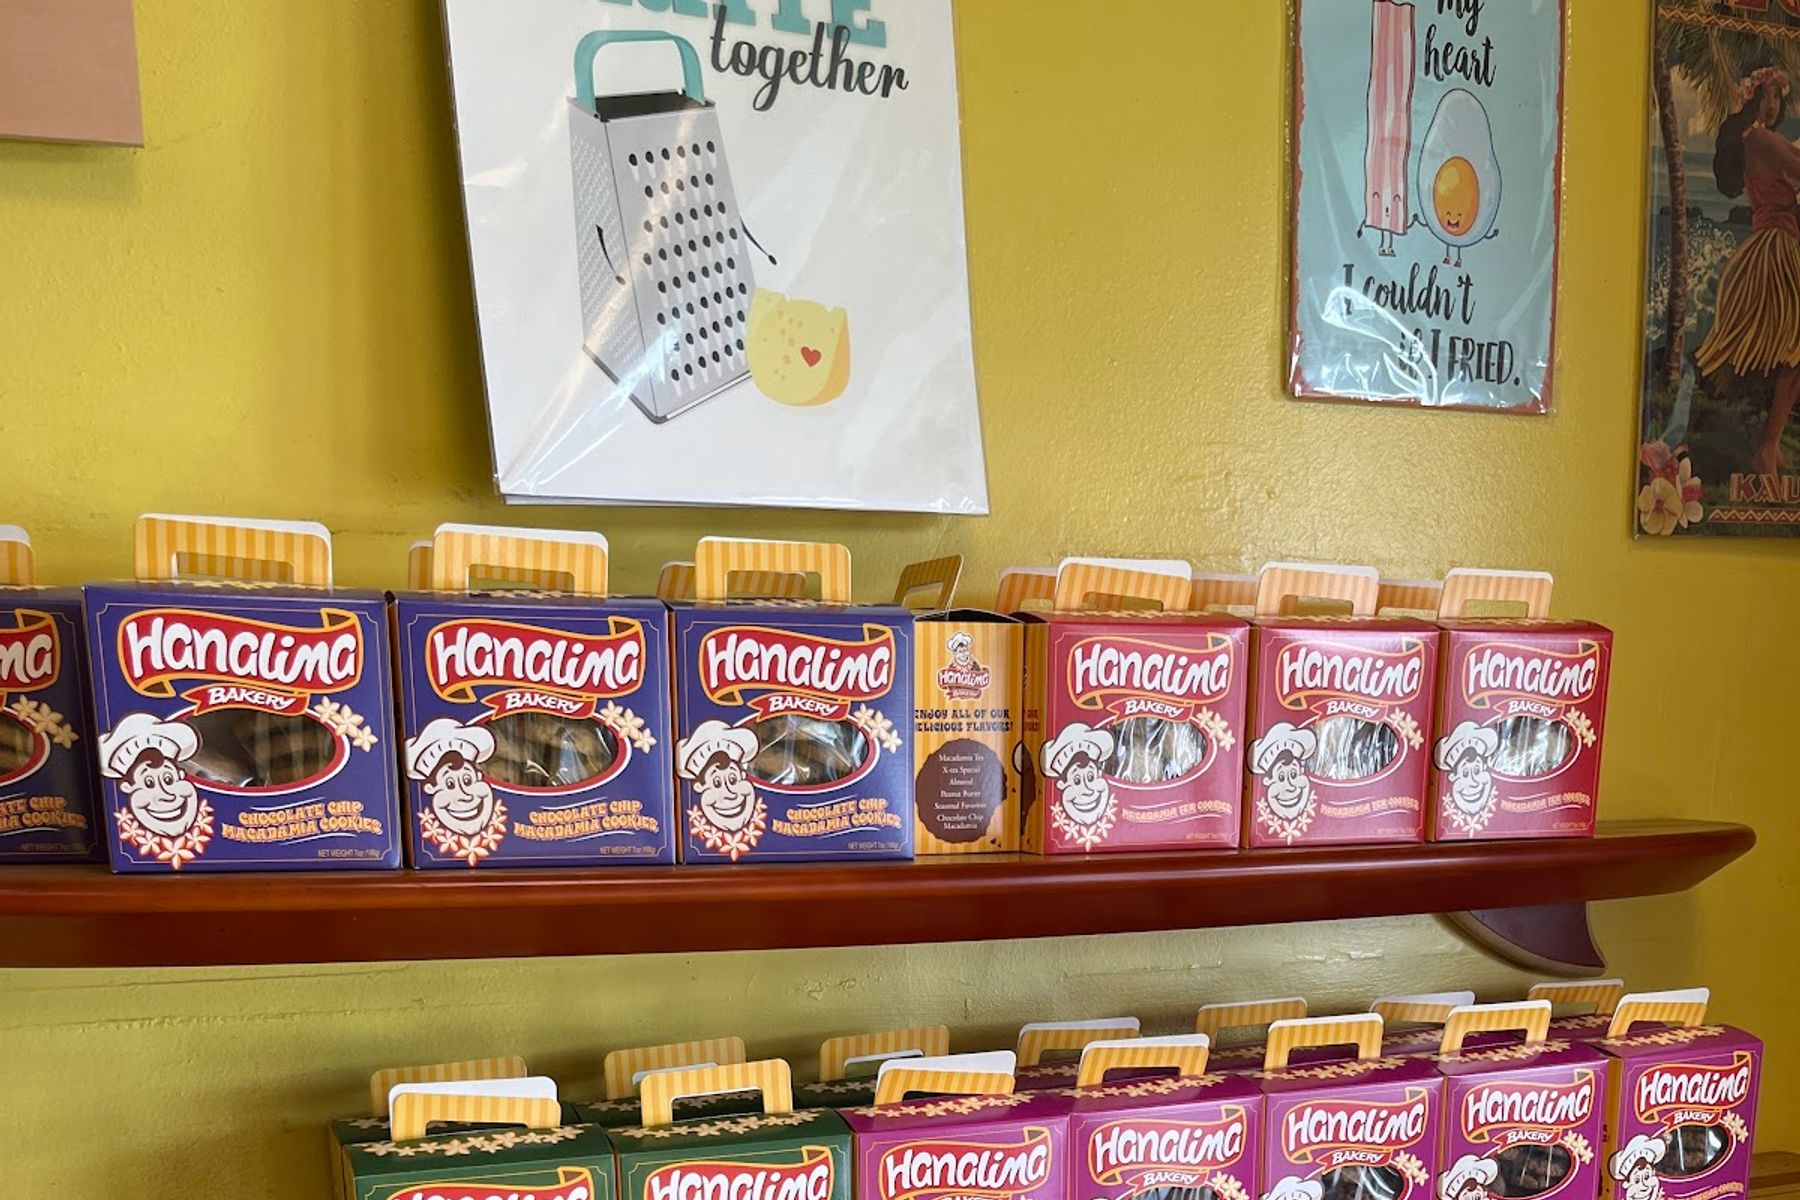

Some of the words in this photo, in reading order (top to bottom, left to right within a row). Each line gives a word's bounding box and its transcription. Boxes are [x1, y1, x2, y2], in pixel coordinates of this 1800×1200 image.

[710, 5, 909, 112] together
[1424, 23, 1496, 88] heart
[1362, 261, 1476, 325] couldn't
[1428, 328, 1442, 379] I
[1447, 335, 1521, 386] FRIED.
[126, 616, 357, 686] Hanalima
[433, 627, 641, 690] Hanalima
[706, 633, 891, 693] Hanalima
[1074, 643, 1230, 696] Hanalima
[1281, 648, 1421, 697] Hanalima
[1468, 647, 1596, 696] Hanalima
[207, 687, 297, 710] BAKERY
[504, 692, 585, 714] BAKERY
[767, 695, 841, 716] BAKERY
[1124, 700, 1184, 718] BAKERY
[1326, 701, 1378, 718] BAKERY
[1507, 700, 1557, 717] BAKERY
[915, 722, 963, 732] ELICIOUS
[951, 709, 971, 719] ALL
[238, 802, 325, 827] CHOCOLATE
[326, 800, 364, 814] CHIP
[529, 802, 608, 826] CHOCOLATE
[609, 799, 644, 813] CHIP
[786, 800, 858, 822] CHOCOLATE
[858, 798, 888, 810] CHIP
[221, 818, 321, 843] MACADAMIA
[319, 814, 384, 836] COOKIES
[513, 818, 603, 841] MACADAMIA
[601, 814, 660, 834] COOKIES
[772, 815, 852, 837] MACADAMIA
[850, 811, 902, 829] COOKIES
[1640, 1066, 1749, 1113] Hanalima
[1466, 1084, 1591, 1131] Hanalima
[1673, 1110, 1716, 1125] BAKERY
[1287, 1102, 1425, 1152] Hanalima
[1506, 1130, 1555, 1144] BAKERY
[1094, 1121, 1243, 1174] Hanalima
[1332, 1151, 1386, 1165] BAKERY
[884, 1144, 1048, 1198] Hanalima
[1143, 1170, 1202, 1186] BAKERY
